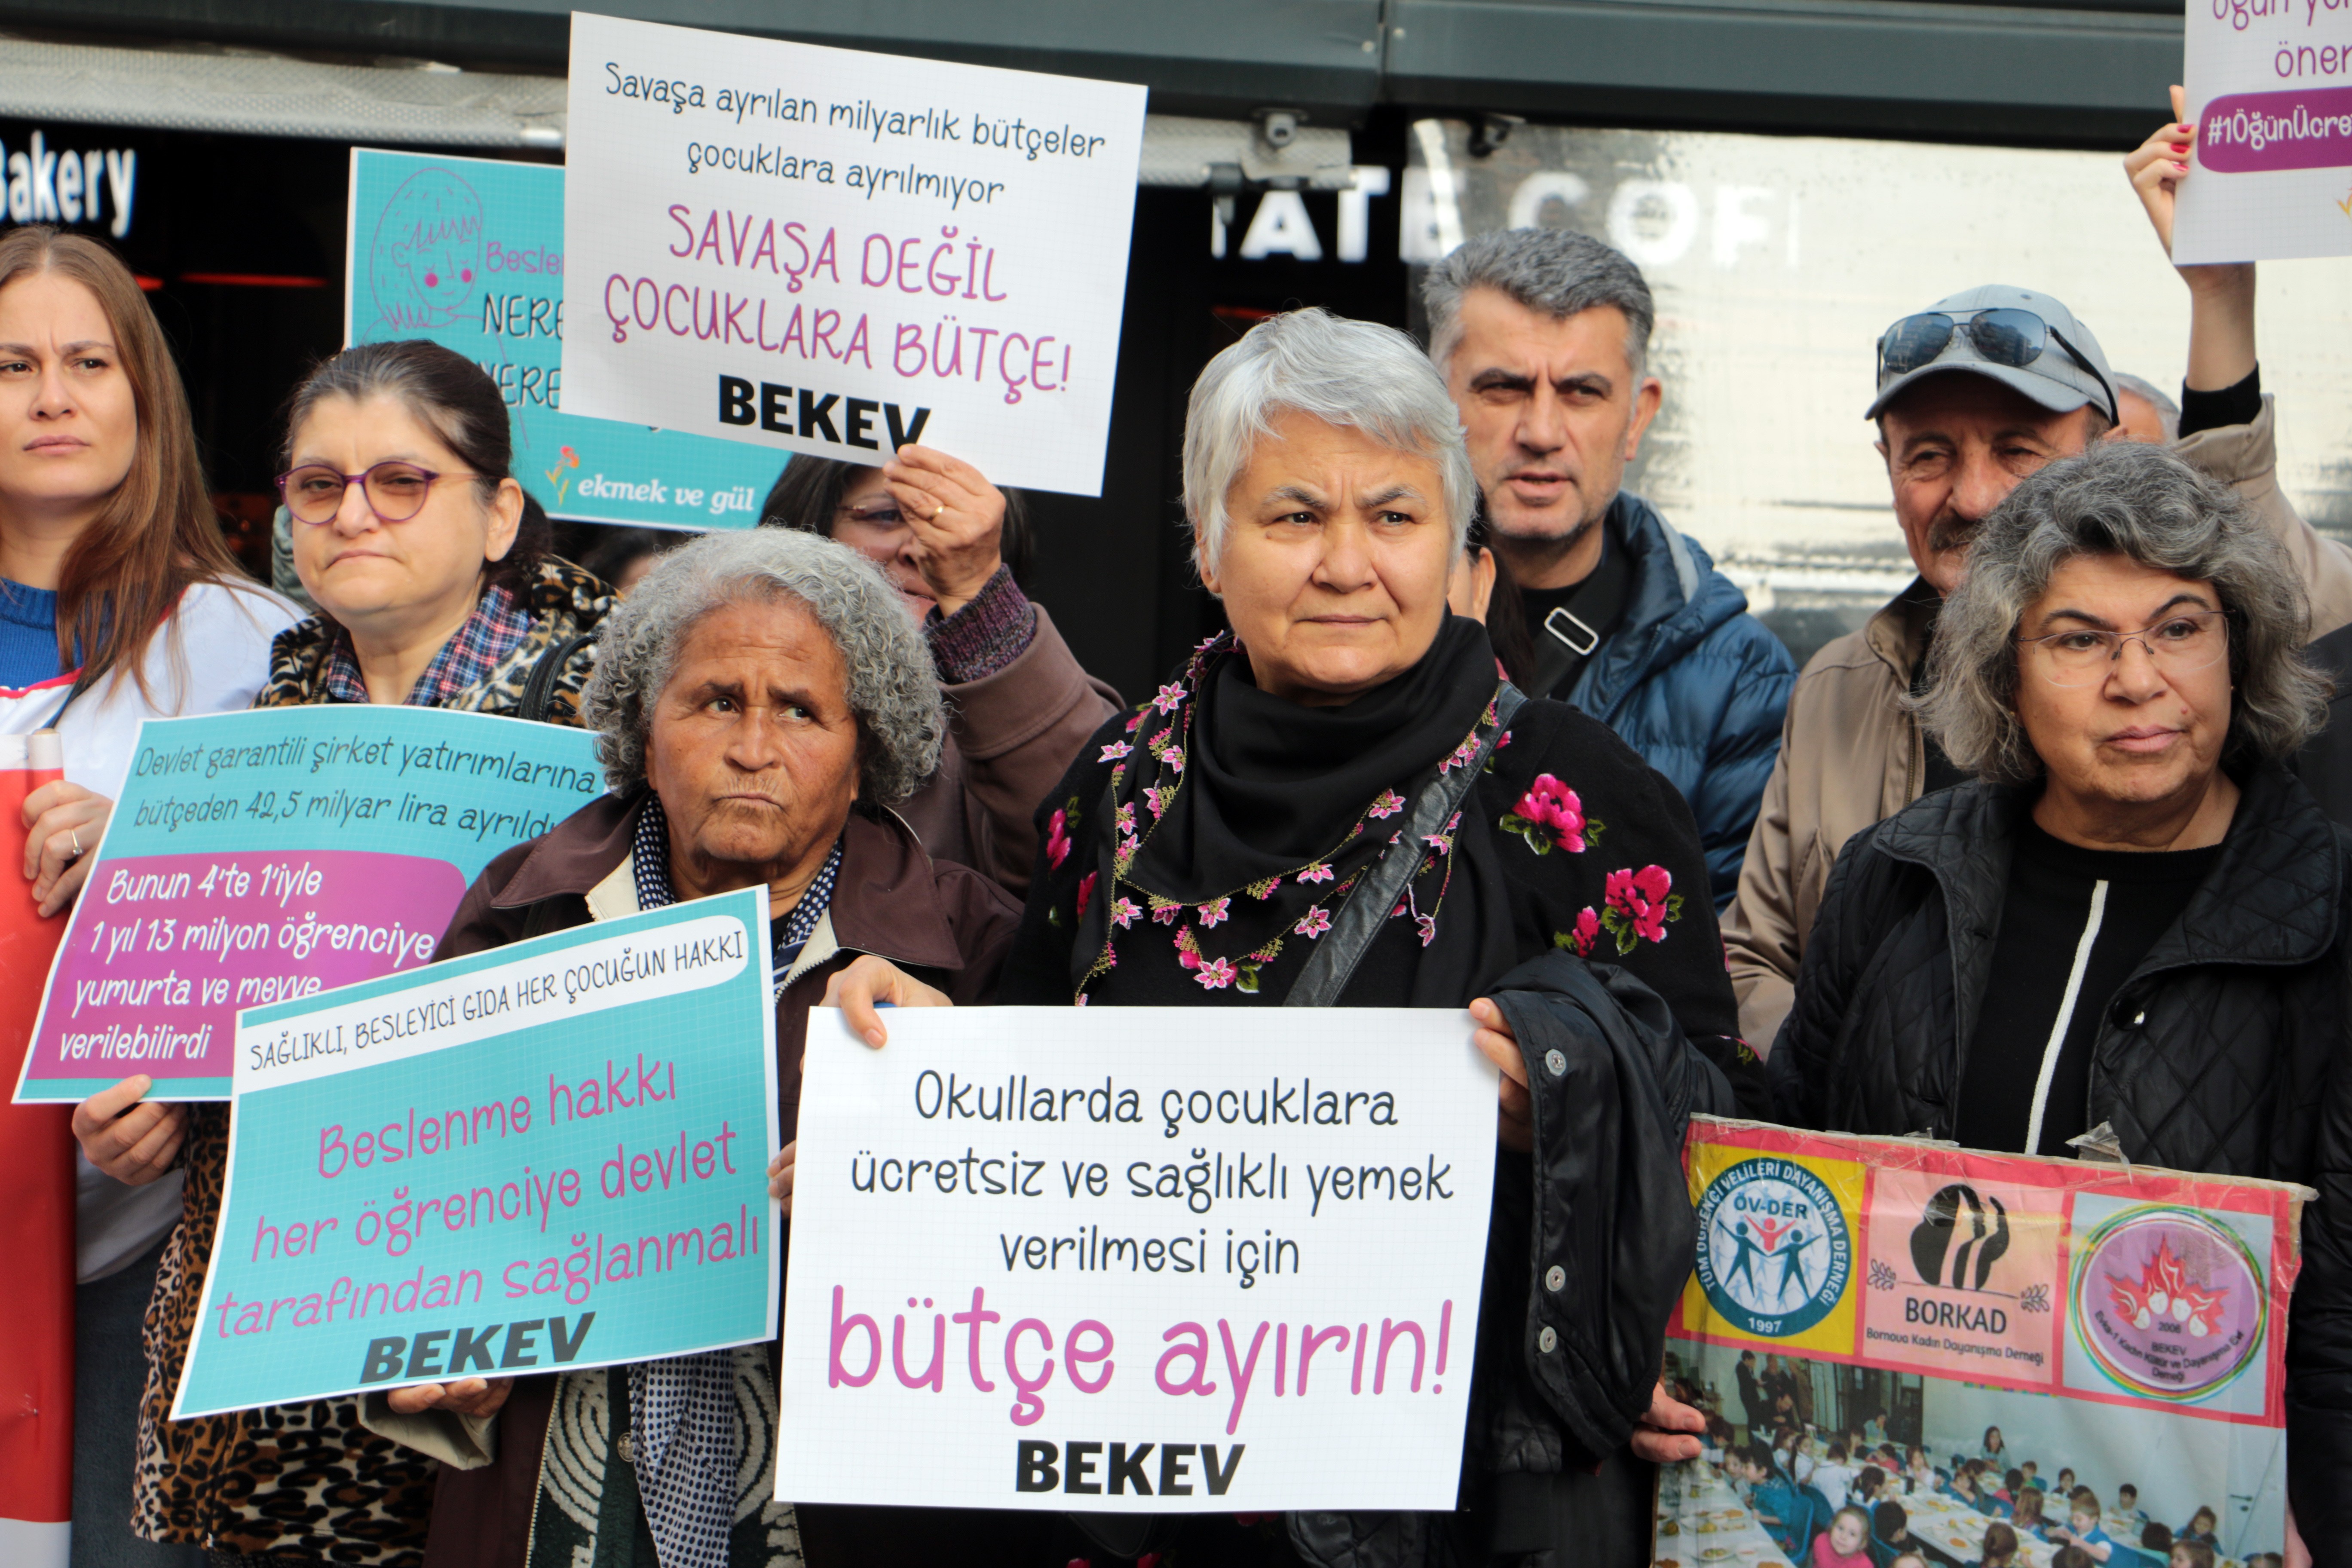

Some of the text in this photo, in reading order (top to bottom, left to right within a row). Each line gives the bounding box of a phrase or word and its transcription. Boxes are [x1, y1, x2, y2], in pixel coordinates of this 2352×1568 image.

[606, 62, 1105, 161] Savaşa ayrılan milyarlık bütçeler
[2208, 104, 2352, 151] #1ÖğünÜcre
[0, 129, 136, 237] akery
[688, 142, 1004, 210] çocuklara ayrılmıyor
[1211, 165, 1466, 263] ATE
[486, 241, 564, 275] Besle
[668, 204, 1006, 301] SAVAŞA DEĞİL
[605, 274, 1070, 404] ÇOCUKLARA BÜTÇE!
[719, 374, 931, 454] BEKEV
[578, 474, 754, 514] ekmek ve gül
[135, 735, 595, 793] Devlet garantili şirket yatırımlarına
[134, 793, 238, 832] bütçeden
[246, 791, 302, 823] 42,5
[306, 789, 392, 827] milyar
[398, 793, 447, 826] lira
[107, 862, 322, 907] Bunun 4'te 1'iyle
[91, 911, 436, 968] 1 yıl 13 milyon öğrenciye
[72, 971, 191, 1018] yumurta
[202, 978, 229, 1005] ve
[251, 931, 742, 1070] SAĞLIKLI, BESLEYİCİ GIDA HER ÇOCUĞUN HAKKI
[60, 1024, 212, 1060] verilebilirdi
[318, 1053, 675, 1178] Beslenme hakkı
[916, 1070, 1398, 1138] Okullarda çocuklara
[252, 1121, 736, 1262] her öğrenciye devlet
[852, 1147, 1453, 1217] ücretsiz ve sağlıklı yemek
[1734, 1192, 1808, 1219] ÖV-DER
[1001, 1225, 1298, 1289] verilmesi için
[1697, 1256, 1716, 1291] TÜM
[1782, 1166, 1841, 1237] DAYANIŞMA
[1819, 1240, 1847, 1307] DERNEĞİ
[215, 1204, 758, 1338] tarafından sağlanmalı
[359, 1312, 596, 1384] BEKEV
[1748, 1317, 1782, 1332] 1997
[1905, 1297, 2007, 1334] BORKAD
[828, 1285, 1452, 1435] bütçe ayırın!
[1911, 1334, 1941, 1348] Kadın
[1944, 1338, 2002, 1357] Dayanışma
[2005, 1347, 2044, 1366] Derneği
[1015, 1439, 1246, 1496] BEKEV
